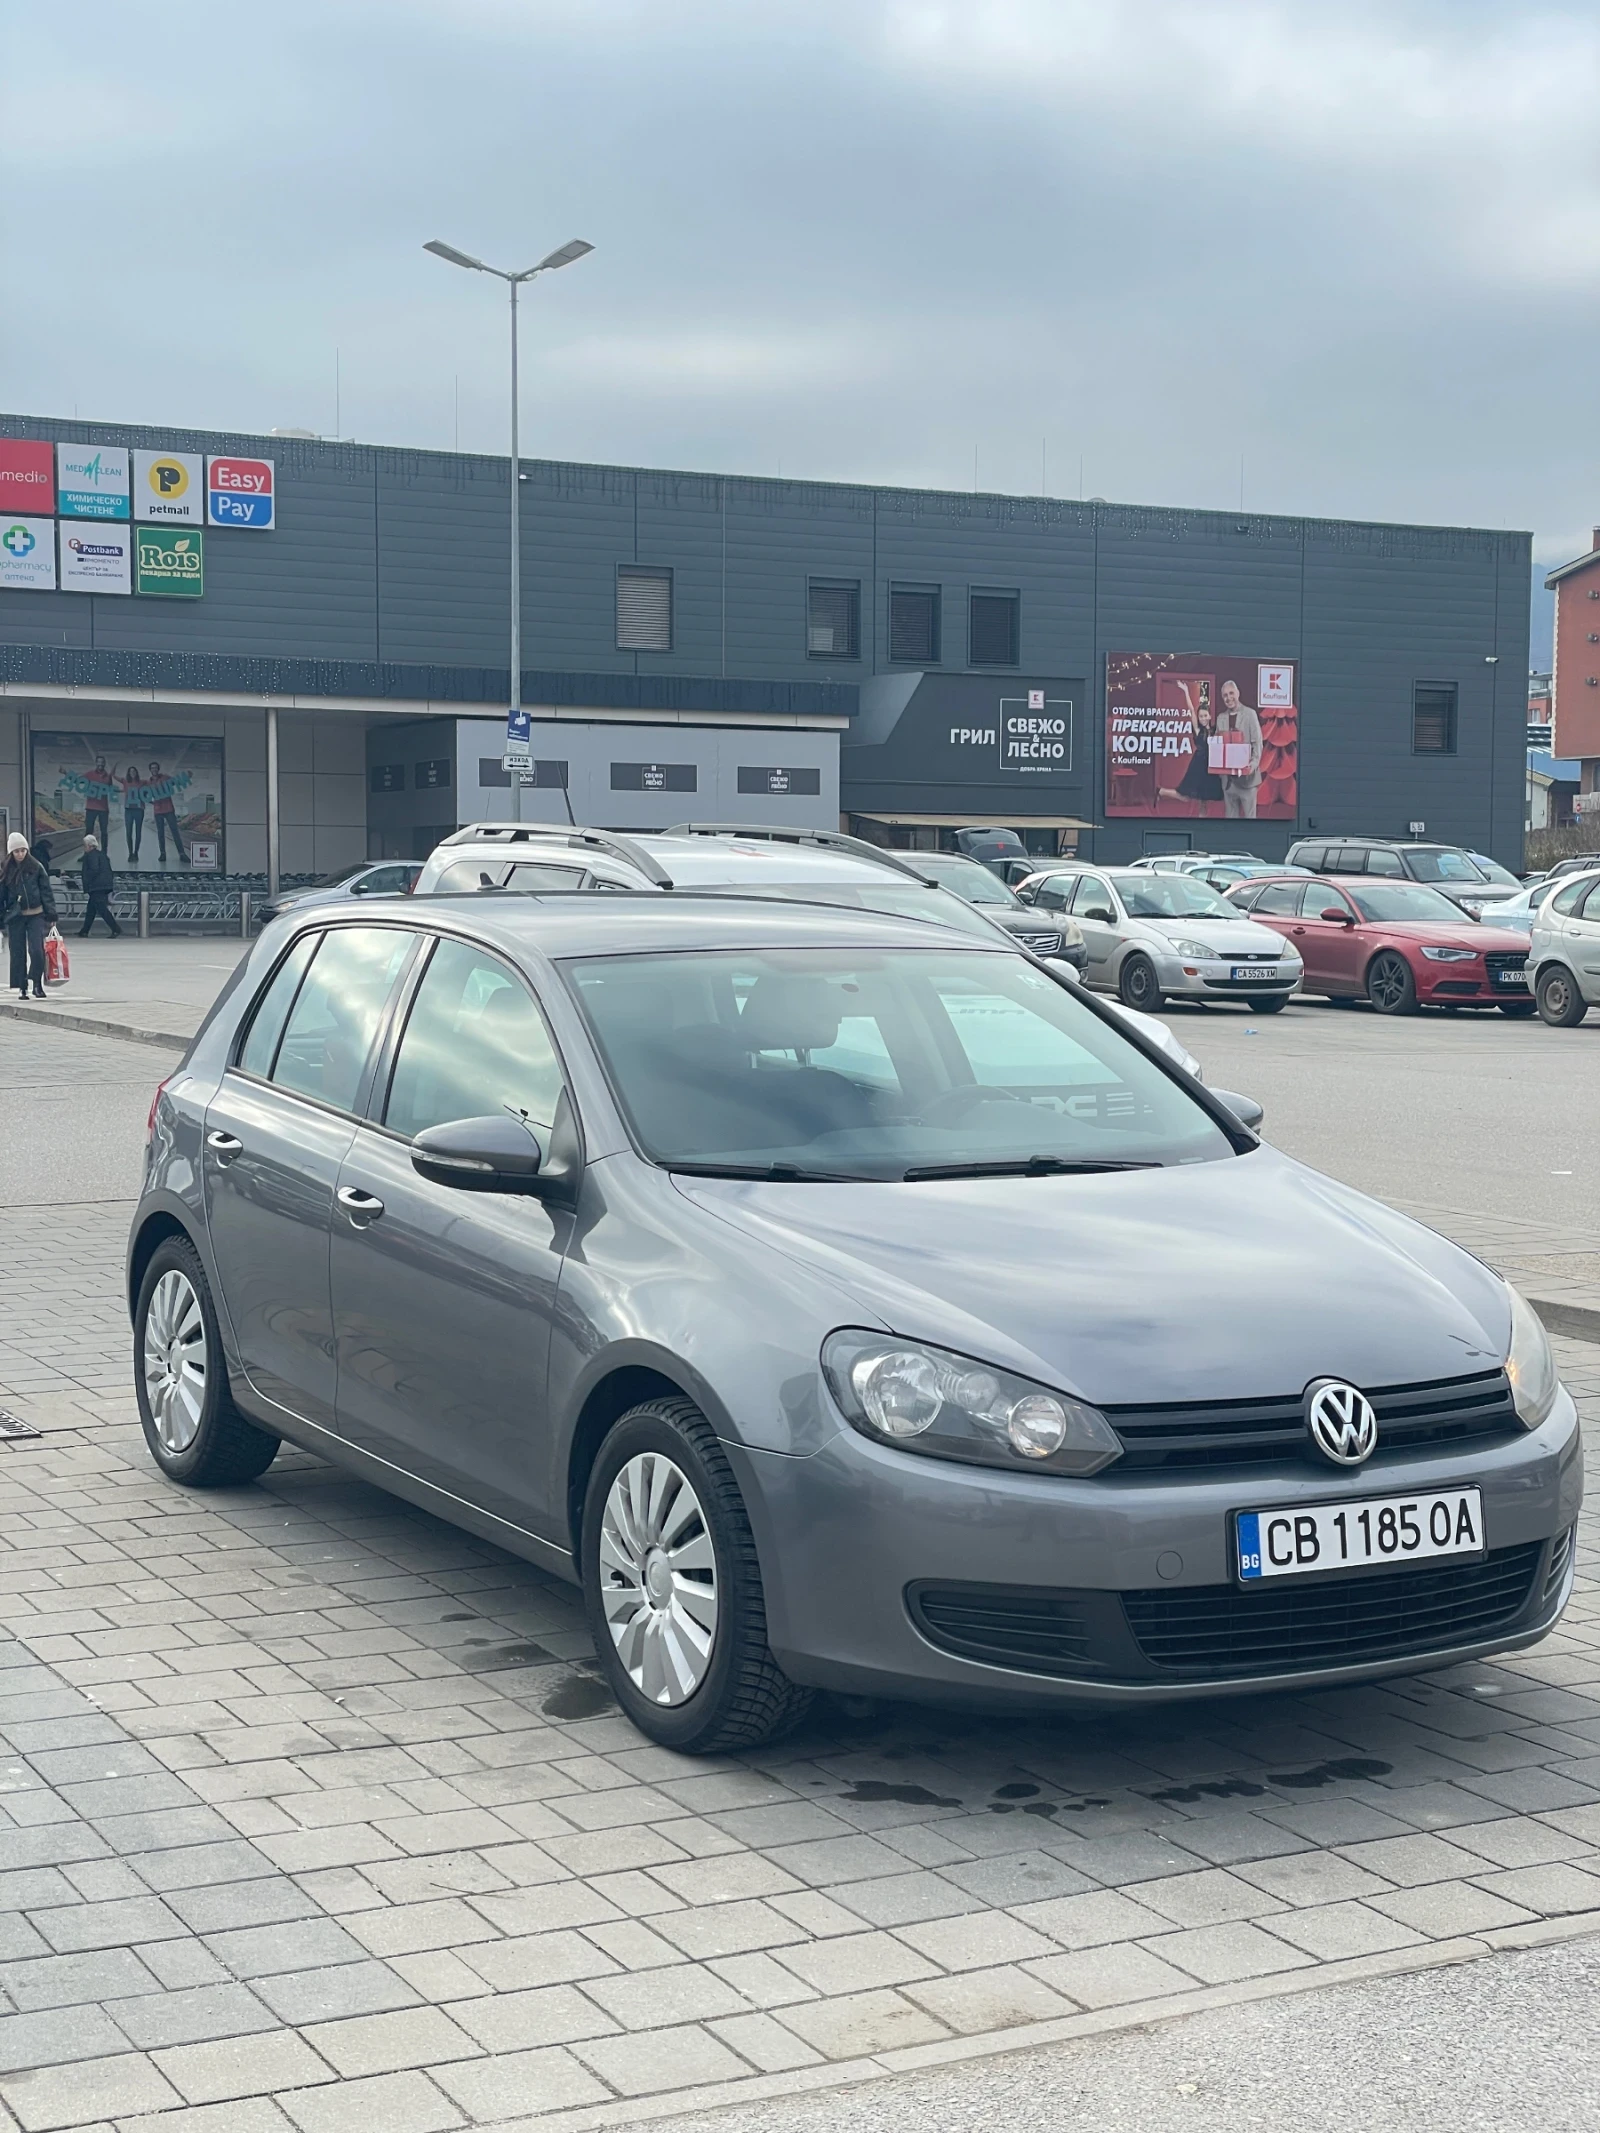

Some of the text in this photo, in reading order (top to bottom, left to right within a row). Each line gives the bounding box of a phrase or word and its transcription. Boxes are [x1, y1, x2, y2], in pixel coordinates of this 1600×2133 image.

[217, 467, 265, 492] Easy
[67, 494, 122, 506] ХИМИЧЕСКО
[74, 505, 115, 515] ЧИСТЕНЕ
[149, 504, 190, 516] petmall
[217, 496, 255, 521] Pay
[83, 545, 120, 555] Postbank
[141, 545, 200, 571] Rois
[0, 560, 52, 574] pharmacy
[5, 574, 35, 582] аптека
[1262, 692, 1288, 700] Kaufland
[1112, 706, 1192, 717] ОТВОРИ ВРАТАТА ЗА
[1007, 717, 1065, 735] СВЕЖО
[1112, 719, 1193, 734] ПРЕКРАСНА
[950, 728, 996, 745] ГРИЛ
[1007, 741, 1065, 759] ЛЕСНО
[1112, 735, 1193, 757] КОЛЕДА
[1117, 756, 1151, 765] Kaufland
[59, 770, 120, 804] ДОБРЕ
[126, 770, 194, 805] ДОШЛИ
[1248, 969, 1265, 978] 5526
[1267, 1515, 1321, 1567] CB
[1333, 1503, 1421, 1560] 1185
[1242, 1554, 1260, 1569] BG
